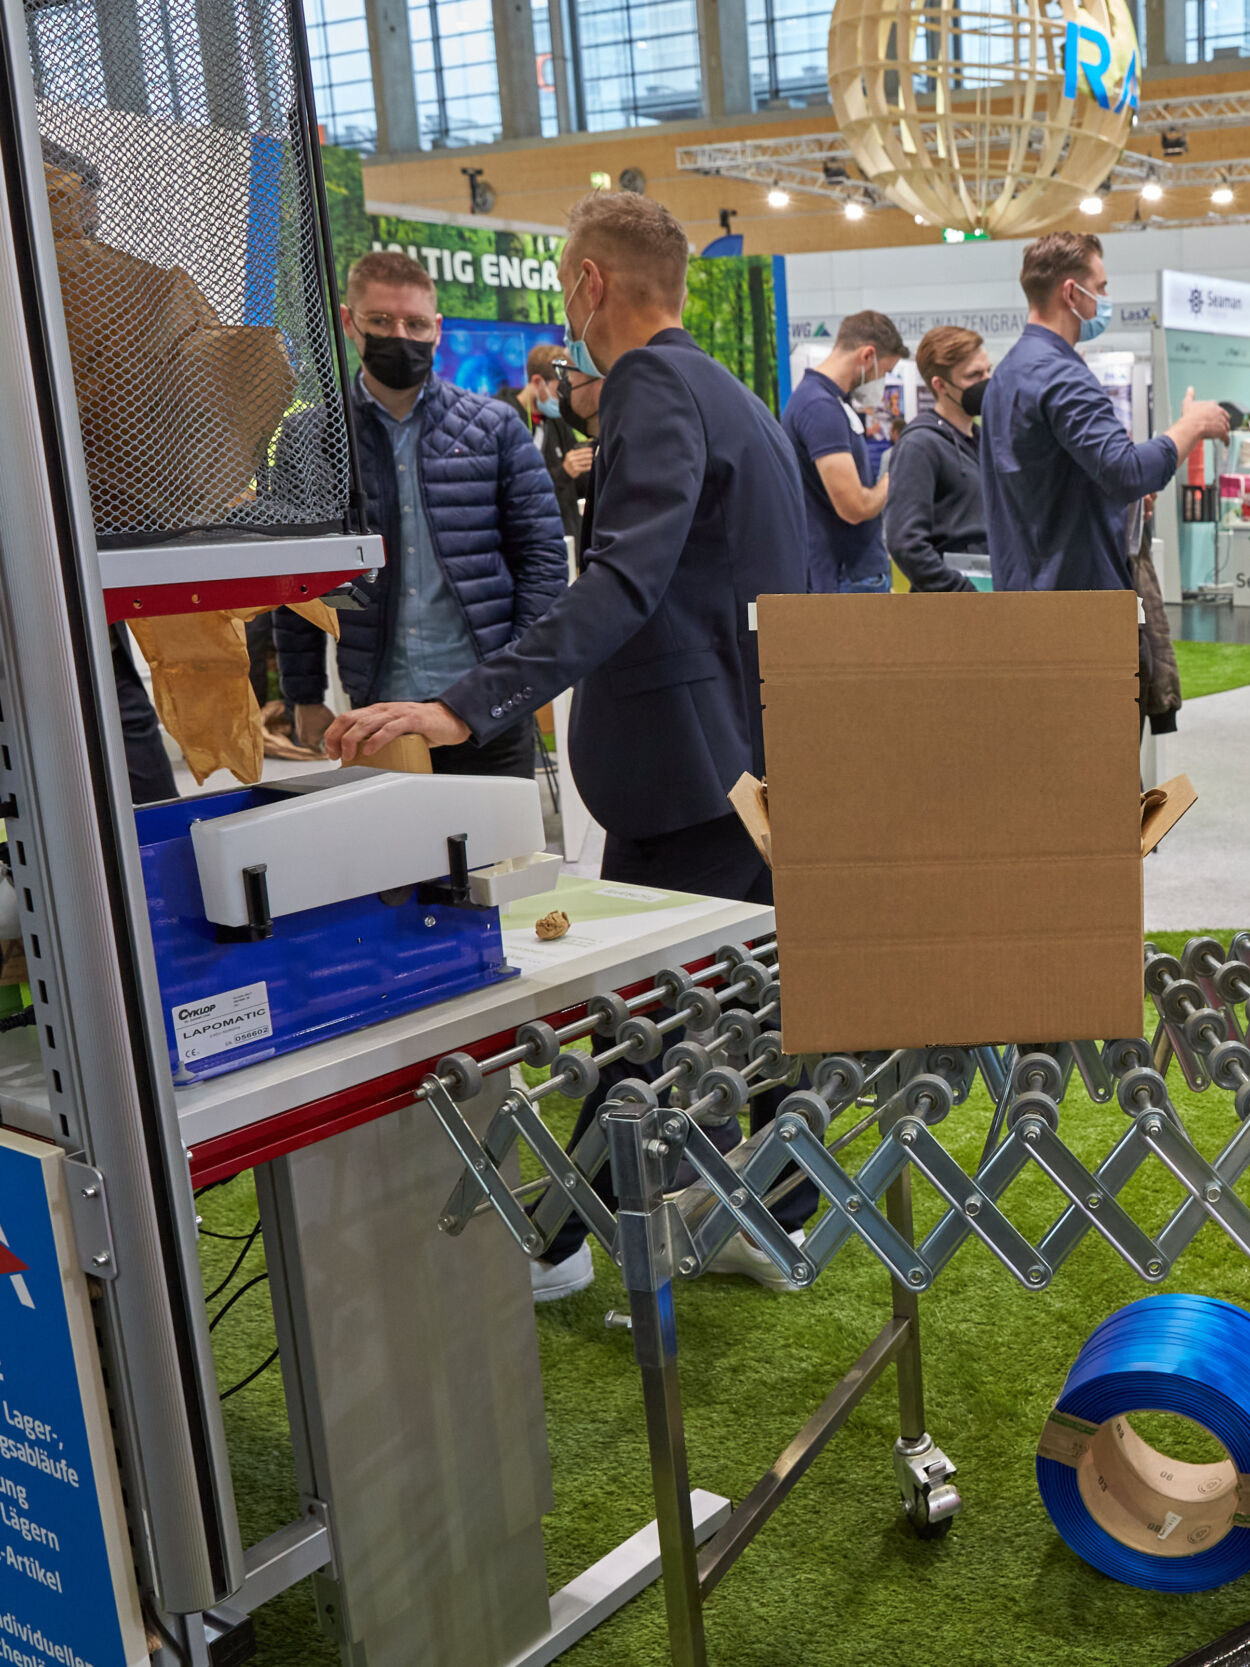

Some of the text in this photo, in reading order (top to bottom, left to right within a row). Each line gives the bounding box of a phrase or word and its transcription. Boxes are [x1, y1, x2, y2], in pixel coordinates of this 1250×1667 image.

[1207, 290, 1242, 310] Seaman
[183, 1008, 267, 1039] LAPOMATIC
[2, 1400, 63, 1450] Lager-,
[0, 1501, 60, 1552] Lägern
